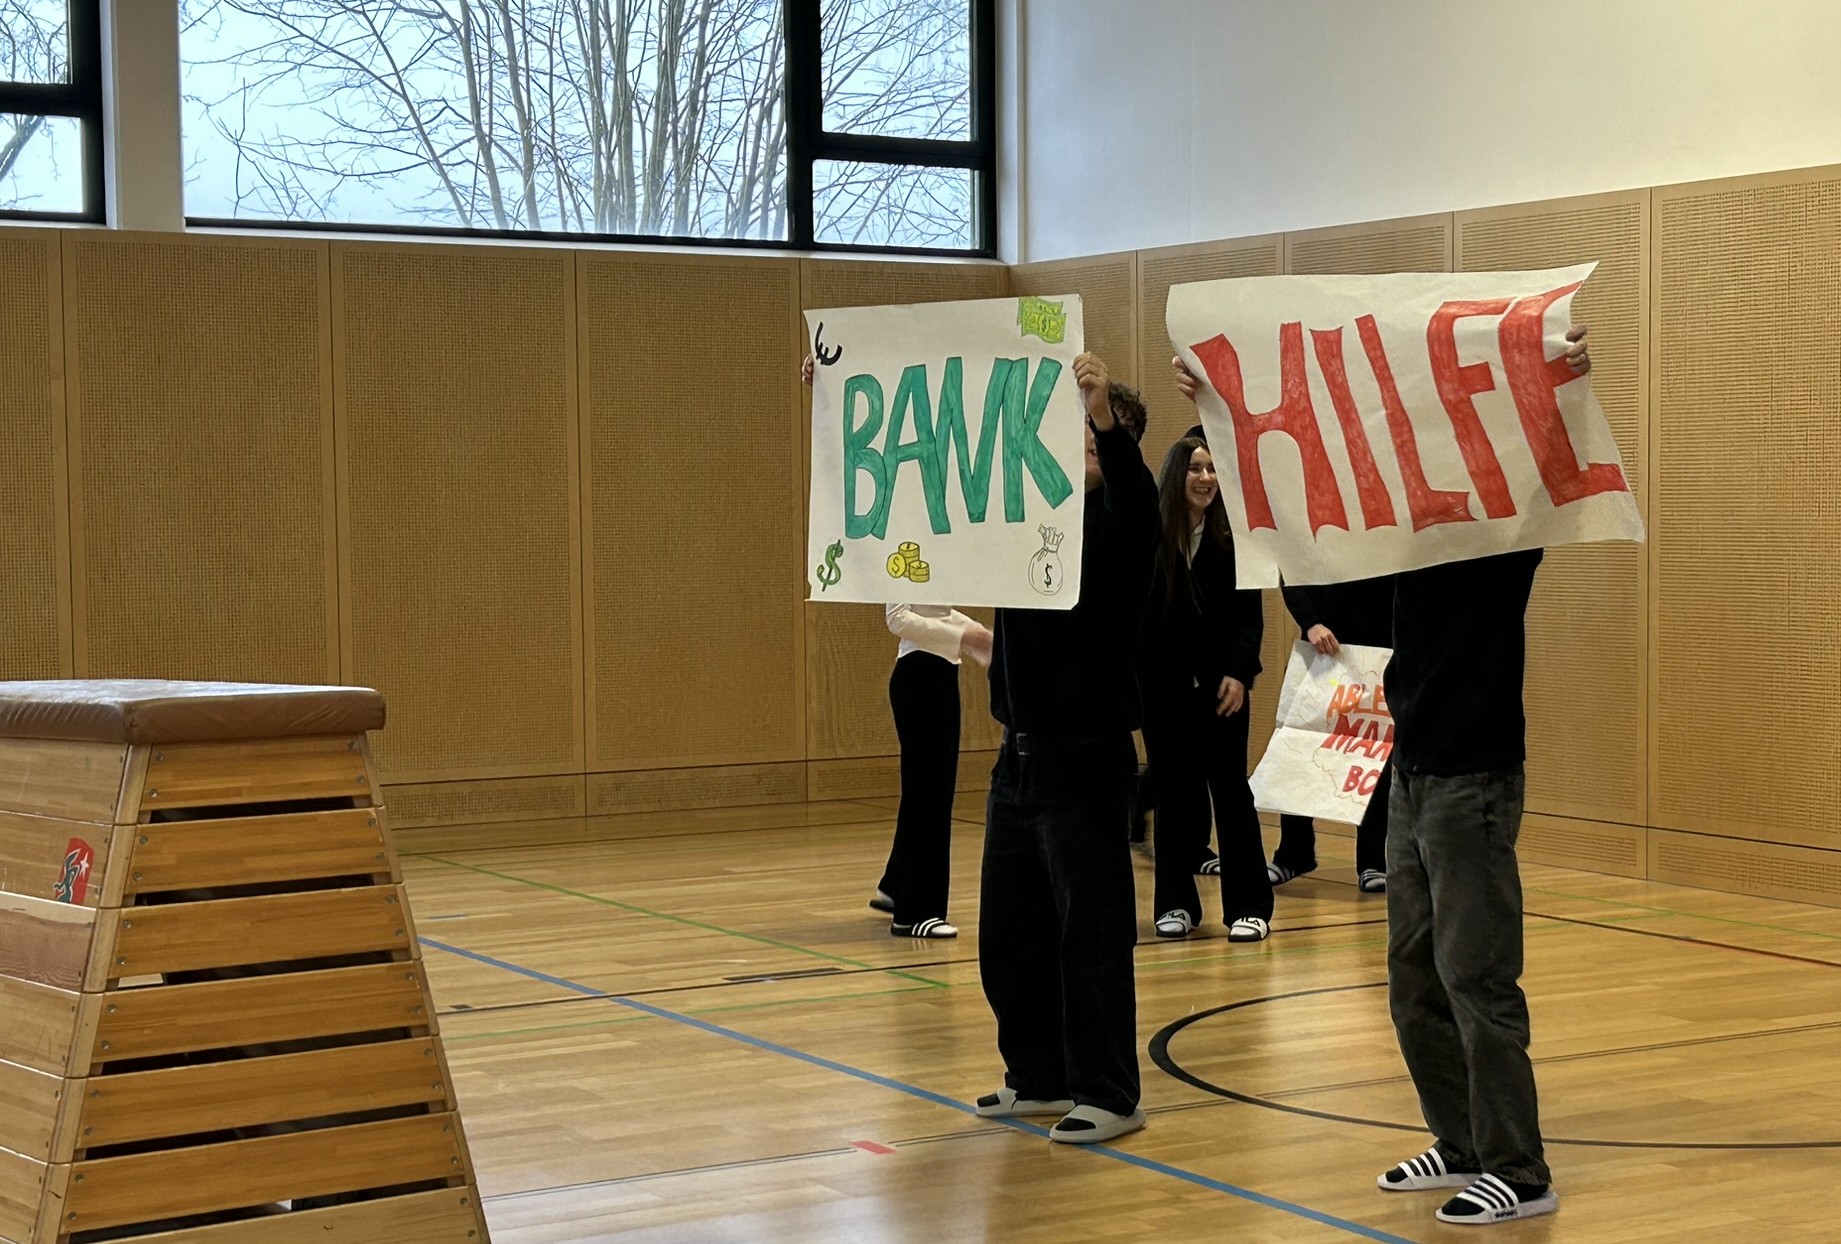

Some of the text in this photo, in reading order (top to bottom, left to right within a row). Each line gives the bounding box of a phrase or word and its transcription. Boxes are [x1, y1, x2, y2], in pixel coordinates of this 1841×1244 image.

[843, 356, 1074, 540] BANK
[1189, 280, 1630, 543] HILFE
[817, 539, 844, 592] $
